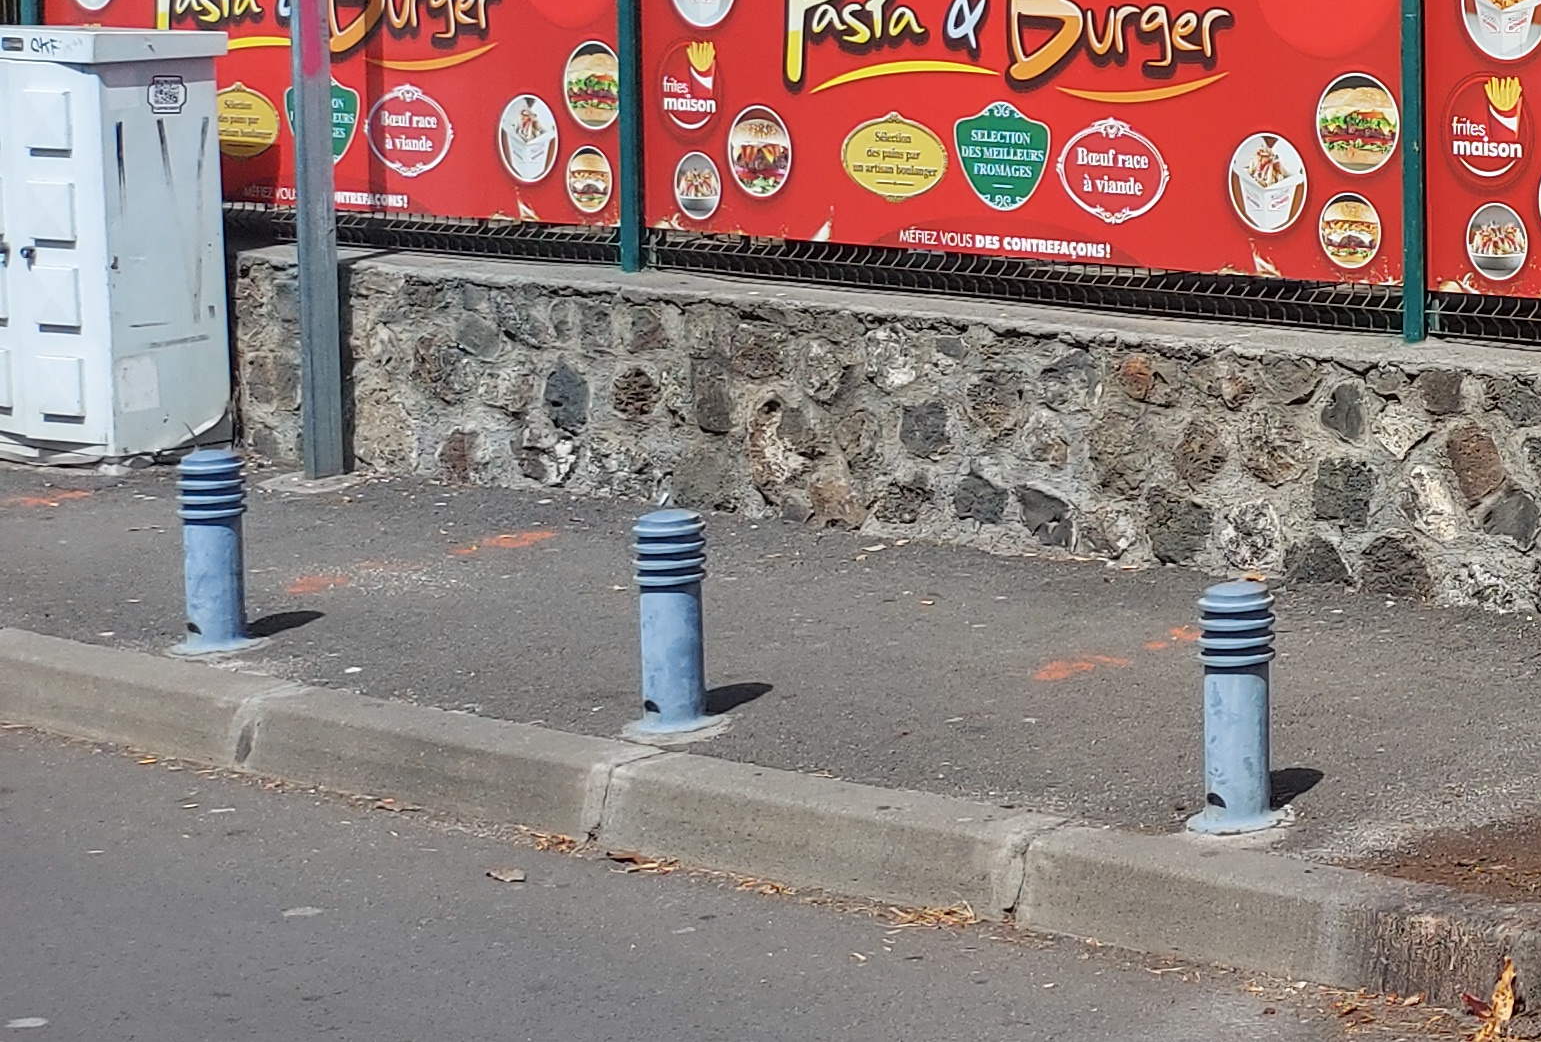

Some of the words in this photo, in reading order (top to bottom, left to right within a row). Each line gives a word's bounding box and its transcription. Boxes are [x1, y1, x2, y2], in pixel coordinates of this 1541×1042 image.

[663, 93, 717, 114] maison
[381, 110, 411, 127] Bœuf
[412, 115, 438, 129] race
[1452, 116, 1486, 136] frites
[385, 133, 393, 150] à
[395, 135, 433, 151] viande
[971, 128, 1031, 146] SELECTION
[961, 145, 982, 159] DES
[983, 146, 1045, 162] MEILLEURS
[1453, 136, 1522, 158] maison
[1076, 147, 1115, 168] Bœuf
[1116, 153, 1149, 170] race
[973, 163, 1033, 178] FROMAGES
[1083, 174, 1092, 193] à
[1095, 176, 1143, 196] viande
[334, 191, 408, 208] ONTREFAÇONS!
[899, 226, 938, 246] MÉFIEZ
[939, 232, 973, 248] VOUS
[975, 234, 1000, 250] DES
[1002, 236, 1112, 259] CONTREFAÇONS!
